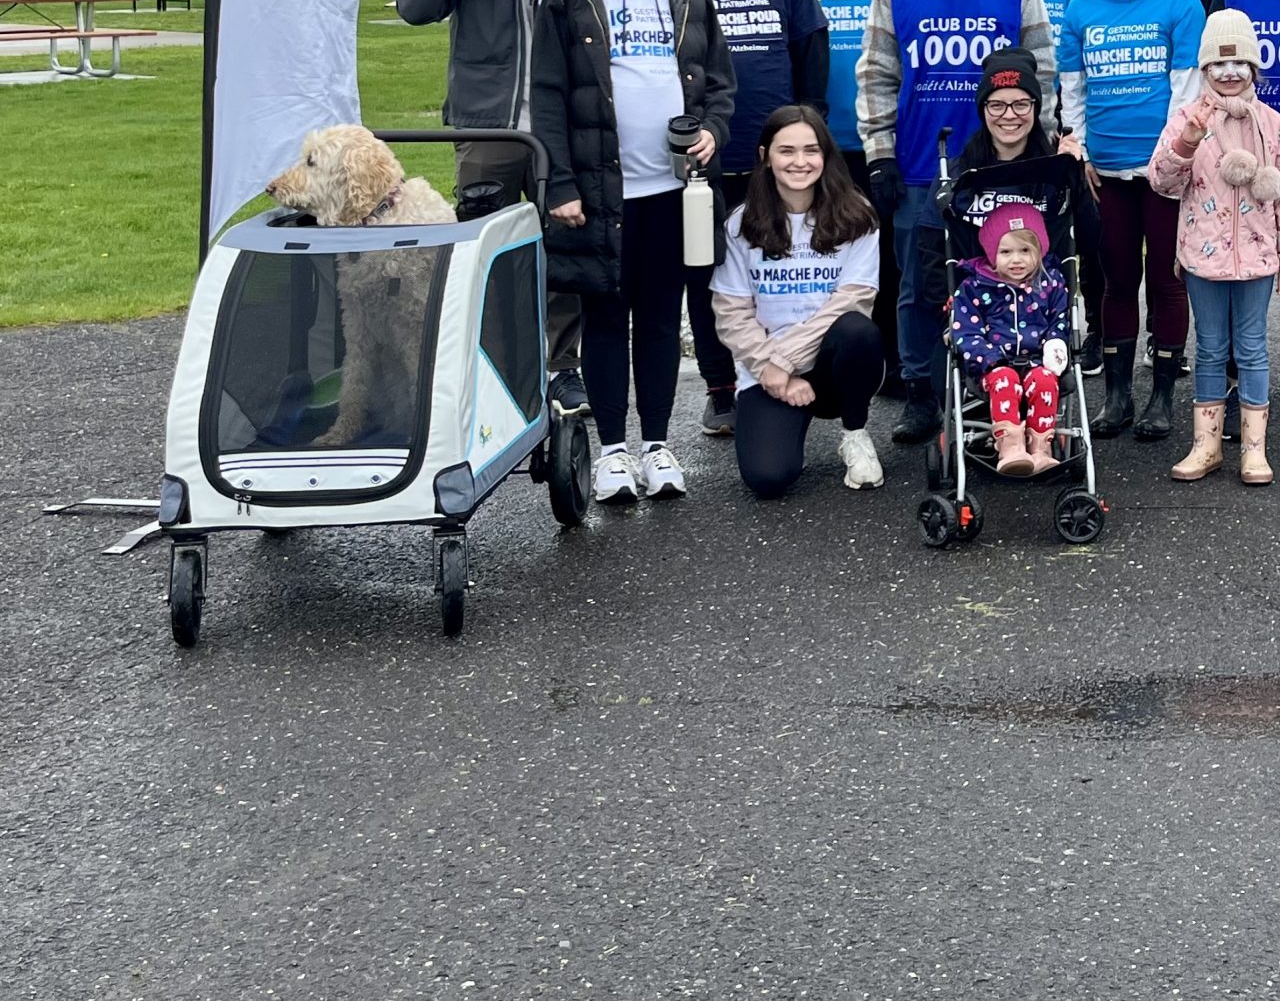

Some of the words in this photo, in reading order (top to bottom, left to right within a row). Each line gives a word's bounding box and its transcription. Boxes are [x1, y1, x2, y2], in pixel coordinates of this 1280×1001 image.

[610, 8, 632, 26] IG
[717, 12, 748, 25] RCHE
[748, 9, 781, 23] POUR
[822, 5, 852, 19] RCHE
[854, 5, 870, 18] PO
[721, 23, 782, 36] ZHEIMER
[919, 17, 960, 33] CLUB
[964, 17, 997, 32] DES
[1085, 27, 1105, 46] IG
[1107, 24, 1145, 35] GESTION
[1146, 23, 1159, 31] DE
[1106, 32, 1159, 43] PATRIMOINE
[731, 44, 769, 52] Alzheimer
[1087, 47, 1131, 65] MARCHE
[1134, 45, 1167, 61] POUR
[1086, 61, 1166, 78] ALZHEIMER
[945, 80, 979, 91] Alzhe
[1111, 85, 1151, 95] Alzheimer
[972, 193, 995, 212] IG
[996, 194, 1033, 204] GESTION
[764, 267, 811, 281] MARCHE
[814, 266, 842, 280] POU
